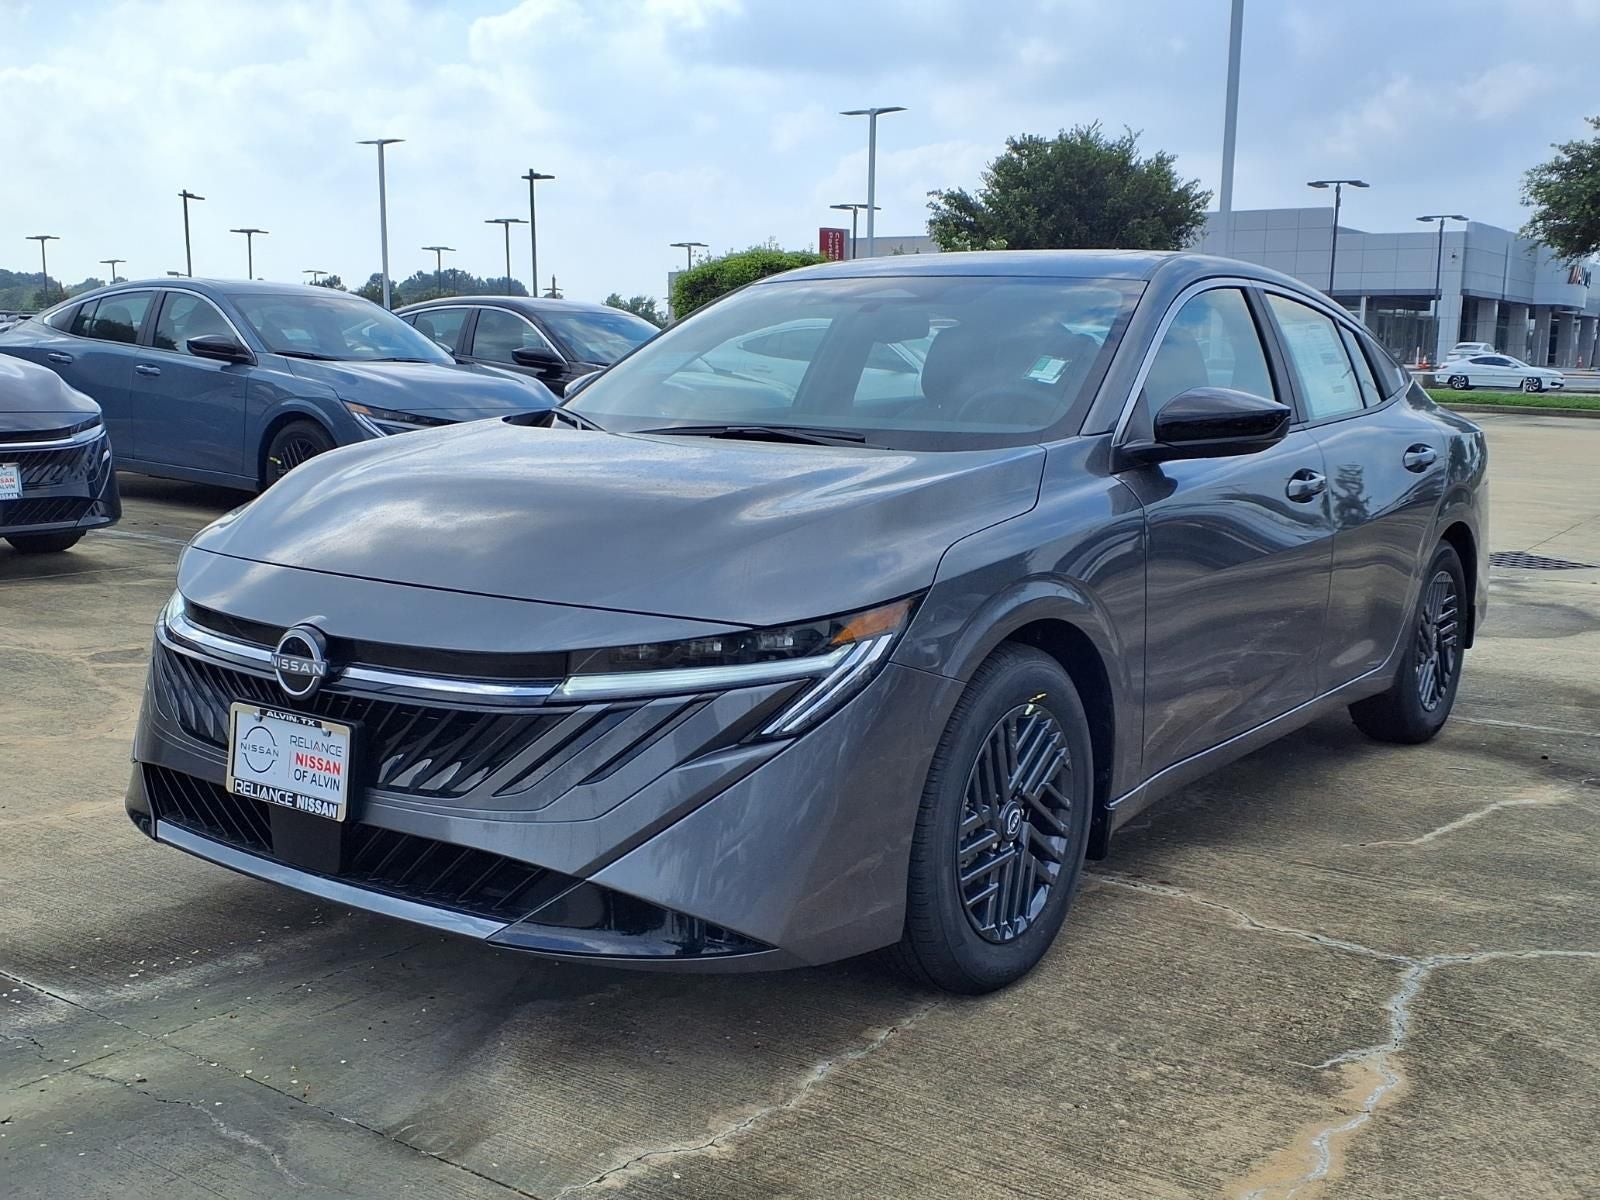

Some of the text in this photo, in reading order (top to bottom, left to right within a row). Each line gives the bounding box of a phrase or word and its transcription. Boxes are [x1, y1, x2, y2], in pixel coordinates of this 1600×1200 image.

[271, 655, 324, 675] NISSAN
[300, 718, 316, 727] TX
[240, 742, 279, 757] NISSAN
[289, 734, 342, 757] RELIANCE
[295, 752, 341, 776] NISSAN
[293, 768, 340, 792] OF ALVIN
[234, 779, 337, 818] RELIANCE NISSAN
